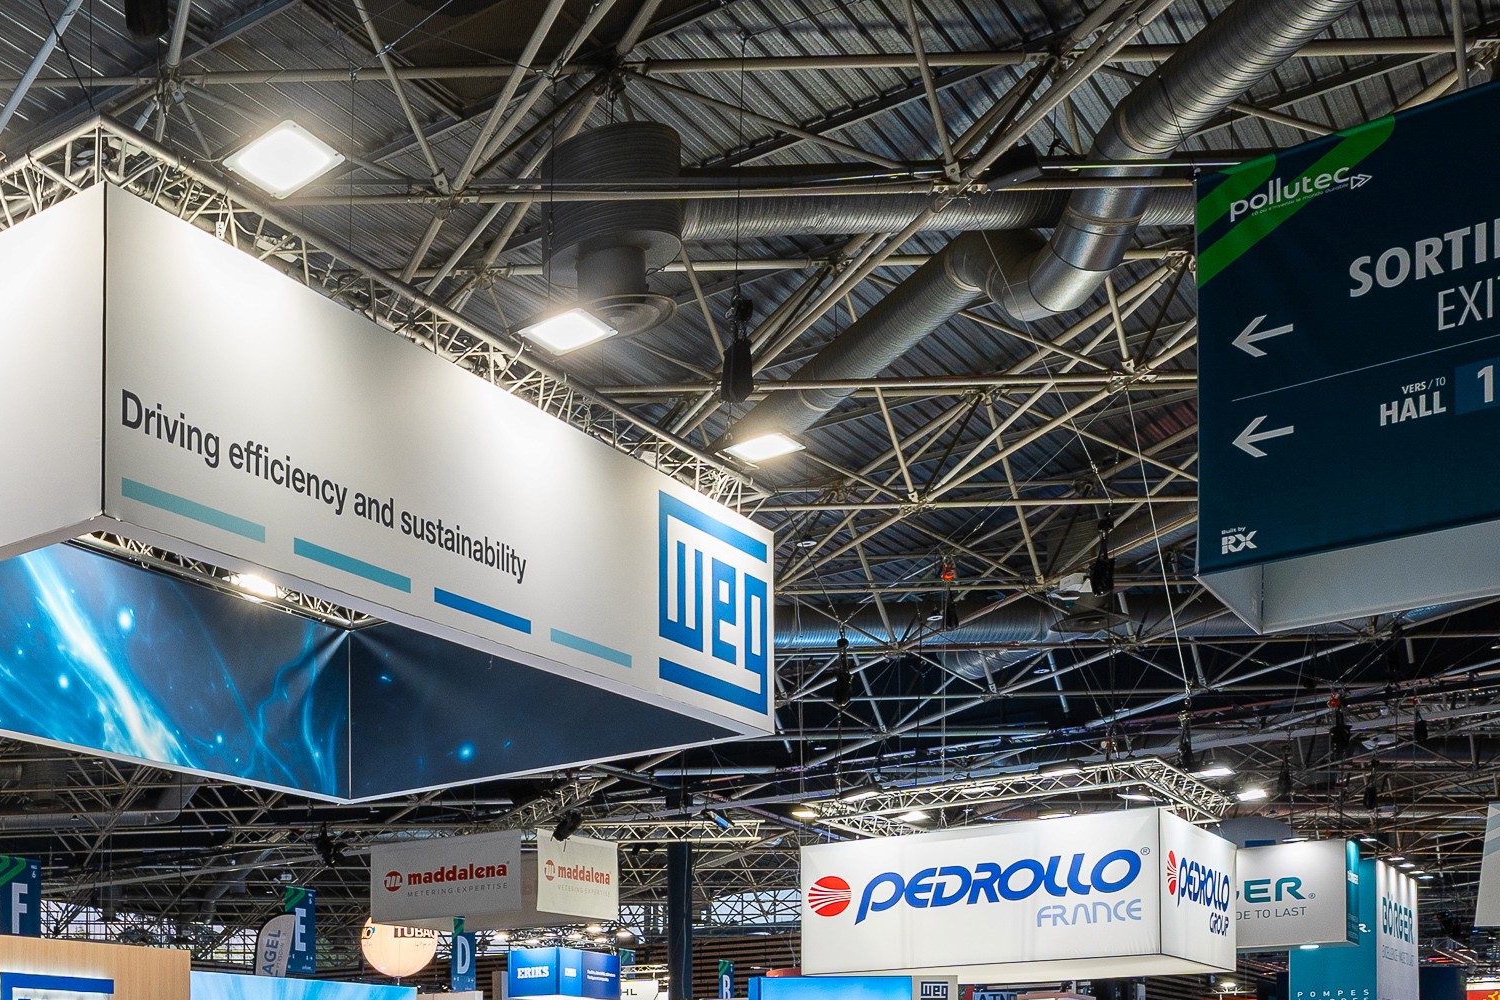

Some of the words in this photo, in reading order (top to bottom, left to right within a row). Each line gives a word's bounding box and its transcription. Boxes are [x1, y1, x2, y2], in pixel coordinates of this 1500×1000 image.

[1230, 167, 1350, 223] pollutec
[1437, 275, 1500, 331] EXI
[1380, 391, 1447, 427] HALL
[1477, 365, 1494, 404] 1
[1402, 381, 1426, 395] VERS
[1435, 376, 1446, 387] TO
[122, 389, 220, 469] Driving
[229, 440, 348, 516] efficiency
[354, 490, 395, 529] and
[400, 508, 527, 584] sustainability
[1221, 530, 1258, 555] RX
[407, 863, 507, 886] maddalena
[407, 887, 453, 897] METERING
[456, 882, 508, 894] EXPERTISE
[557, 864, 610, 886] maddalena
[854, 849, 1141, 926] PEDROLLO
[1177, 857, 1230, 913] PEDROLLO
[11, 882, 28, 934] F
[1036, 898, 1142, 928] FRANCE
[1209, 911, 1230, 937] GROUP
[1255, 908, 1271, 918] TO
[1275, 906, 1307, 918] LAST
[1381, 891, 1415, 945] BÖRGER
[294, 907, 307, 952] E
[457, 936, 471, 975] D
[517, 965, 550, 979] ERIKS
